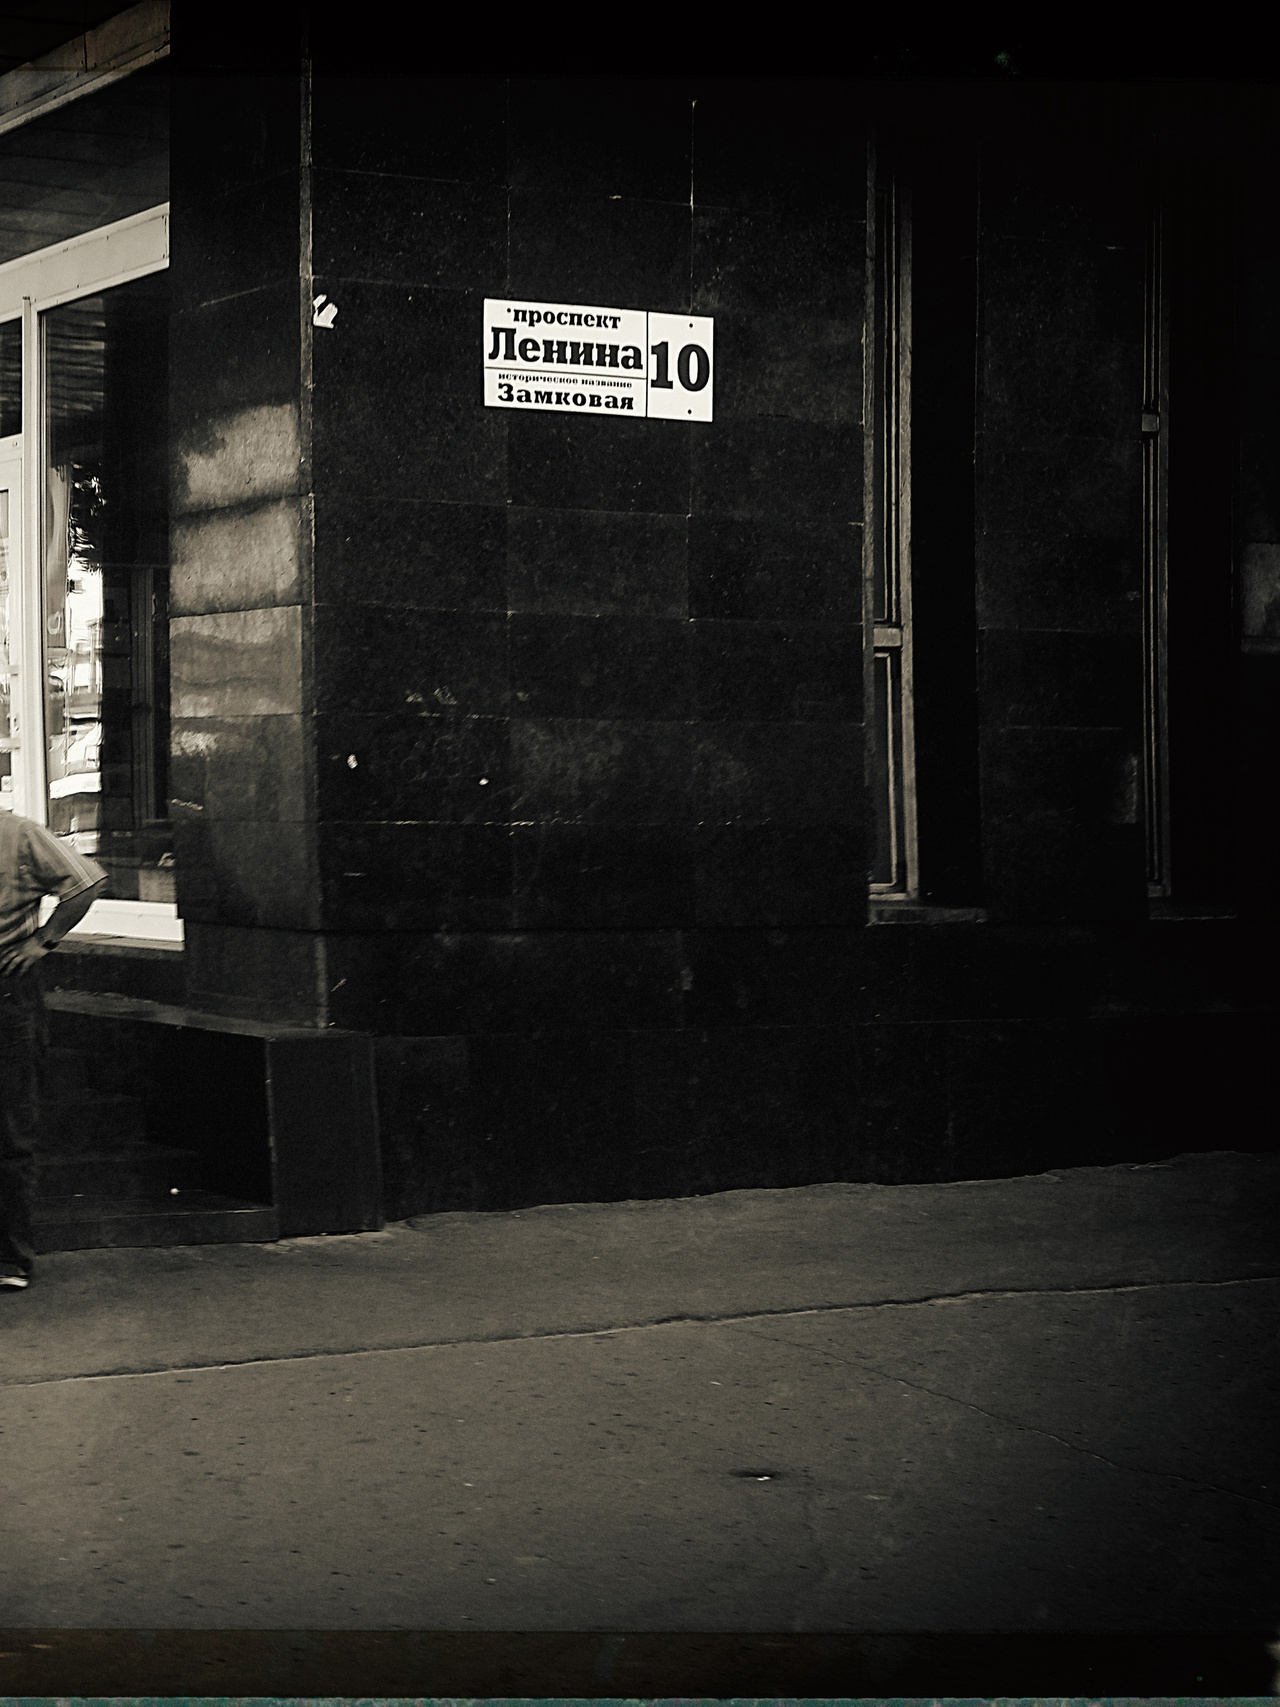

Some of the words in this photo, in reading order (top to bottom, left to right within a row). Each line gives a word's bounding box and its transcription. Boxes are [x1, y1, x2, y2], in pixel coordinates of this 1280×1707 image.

[513, 308, 621, 329] проспект
[488, 326, 643, 370] Ленина
[650, 341, 710, 391] 10
[498, 372, 578, 384] историческое
[581, 378, 632, 389] название
[497, 382, 634, 410] Замковая
